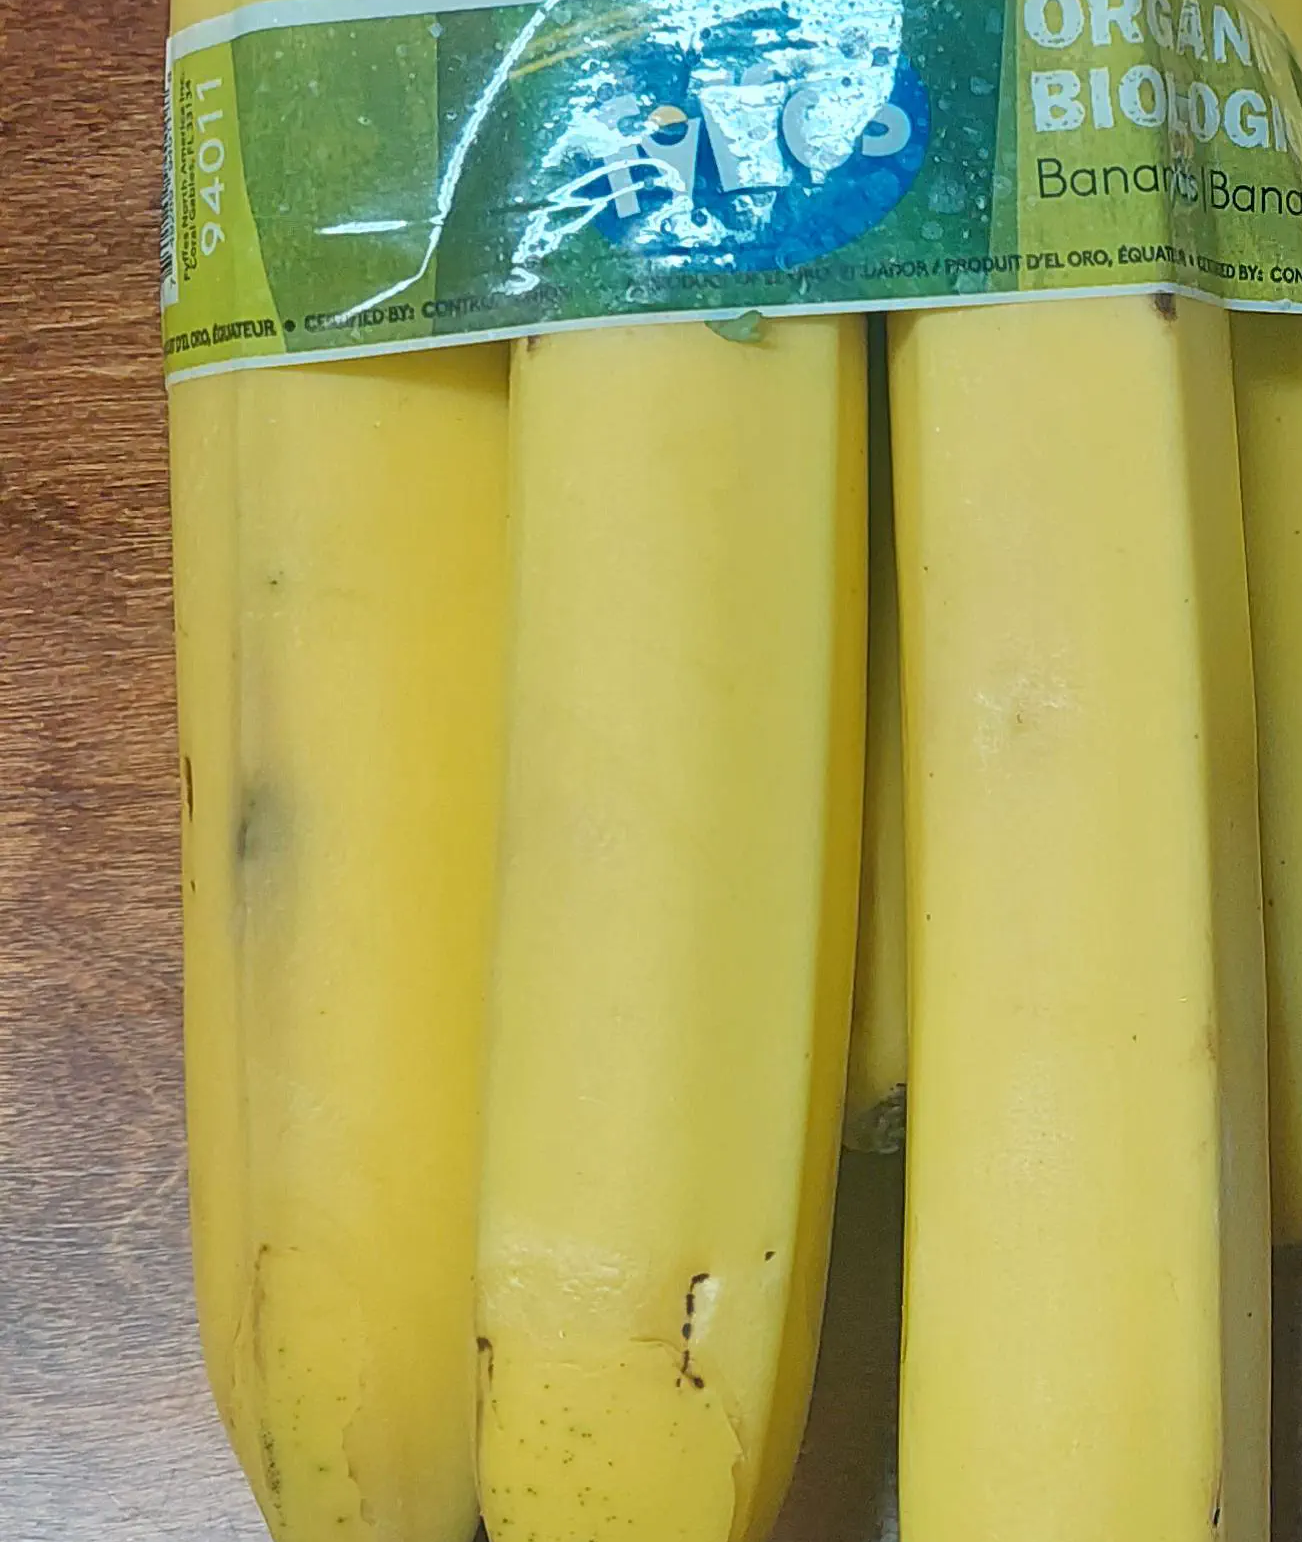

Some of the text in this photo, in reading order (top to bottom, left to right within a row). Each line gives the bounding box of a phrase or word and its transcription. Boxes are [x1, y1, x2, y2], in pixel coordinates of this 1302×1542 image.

[196, 78, 226, 256] 94011
[1067, 248, 1113, 269] ORO,
[1239, 263, 1264, 283] BY:
[388, 302, 416, 323] BY:
